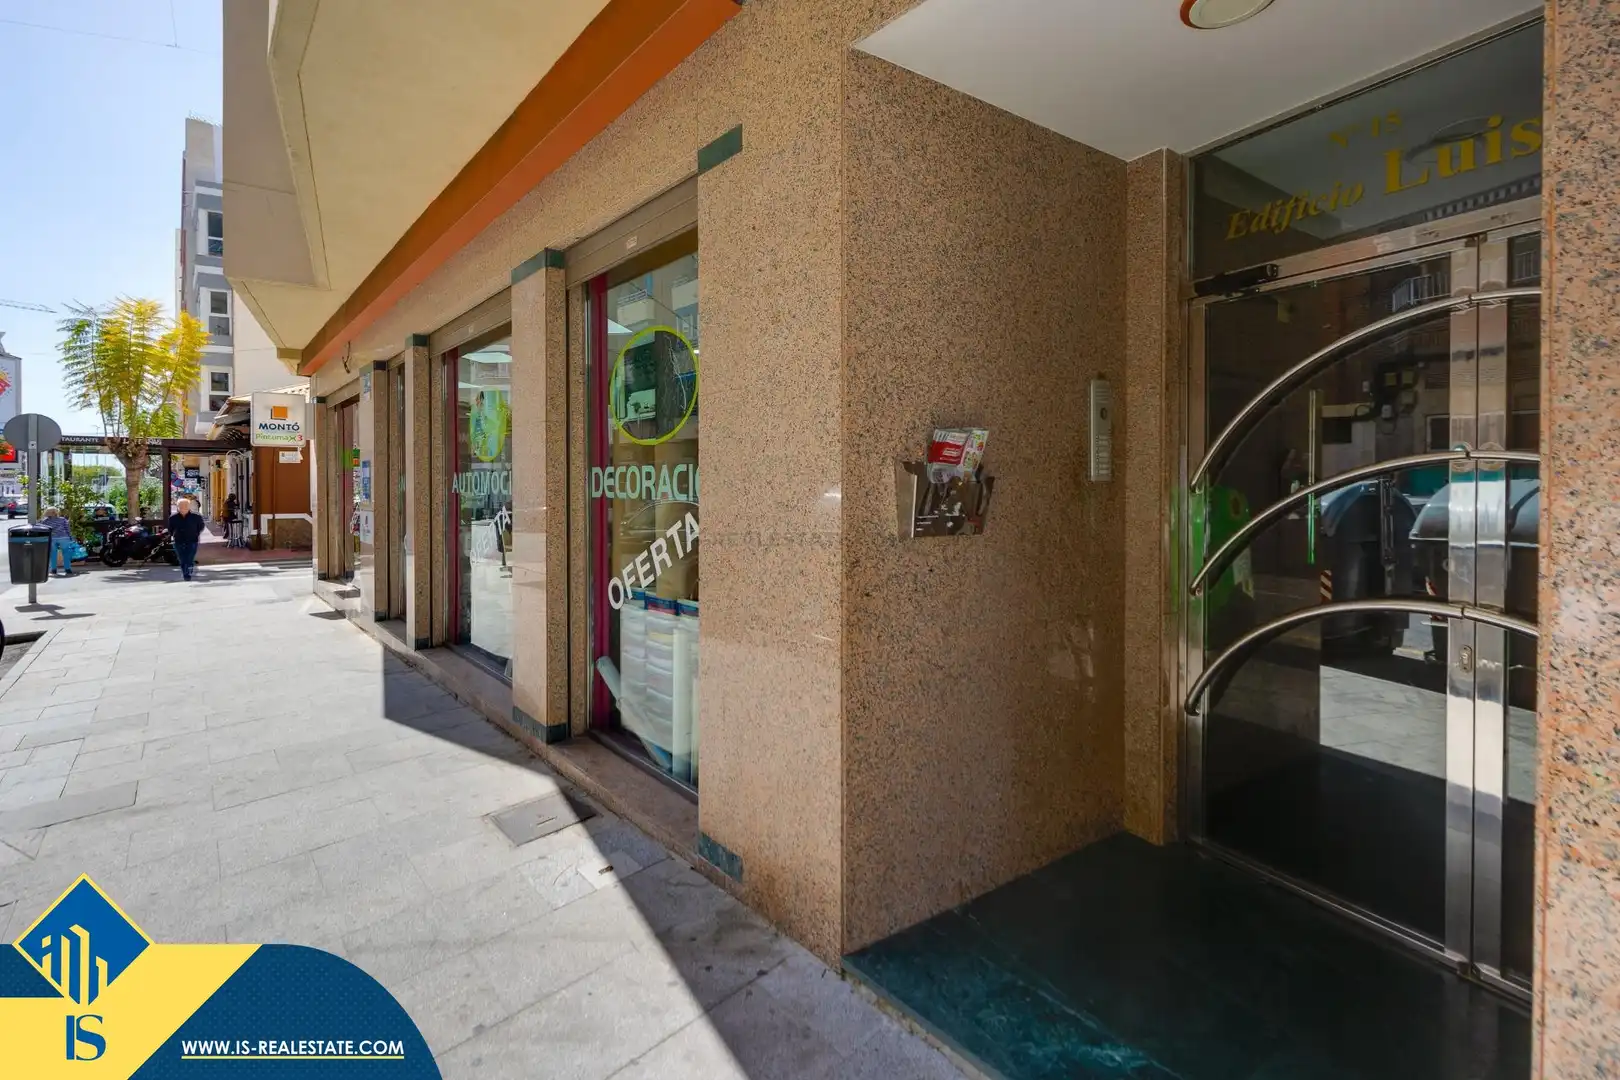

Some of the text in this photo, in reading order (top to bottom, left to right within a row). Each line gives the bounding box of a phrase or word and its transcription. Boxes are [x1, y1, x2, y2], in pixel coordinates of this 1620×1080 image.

[1226, 115, 1542, 240] Edificio Luis
[258, 421, 300, 431] MONTÓ
[608, 511, 700, 610] OFERTA
